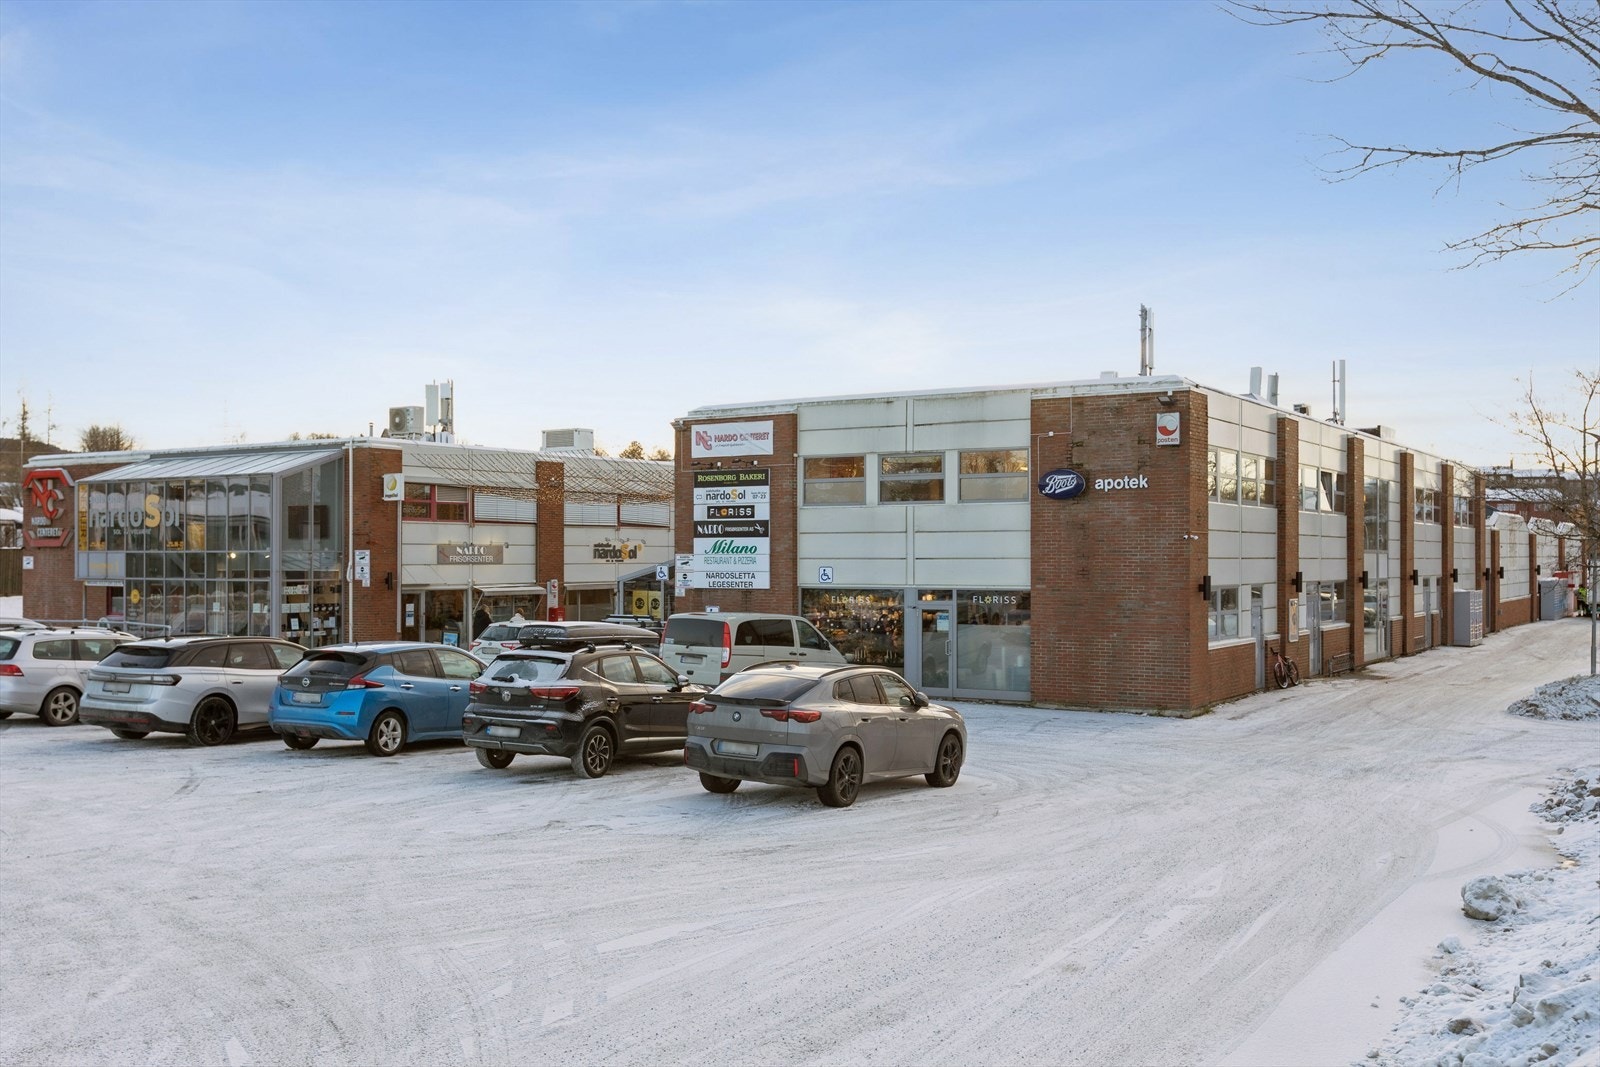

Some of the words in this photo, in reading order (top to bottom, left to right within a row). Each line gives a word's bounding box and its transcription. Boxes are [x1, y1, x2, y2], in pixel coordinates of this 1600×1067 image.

[714, 434, 738, 442] NARDO
[1042, 475, 1077, 494] Boots
[1095, 474, 1149, 492] apotek
[705, 489, 746, 501] nardoSol
[709, 507, 753, 517] FLORISS
[697, 524, 725, 535] NARDO
[456, 546, 487, 555] NARDO
[593, 543, 638, 560] nardoSol
[704, 539, 758, 555] Milano
[704, 556, 733, 565] RESTAURANT
[733, 556, 738, 564] &
[738, 556, 757, 565] PIZZERIA
[705, 572, 757, 580] NARDOSLETTA
[708, 580, 754, 588] LEGESENTER
[831, 595, 871, 604] FLORISS
[972, 595, 1017, 604] FLORISS
